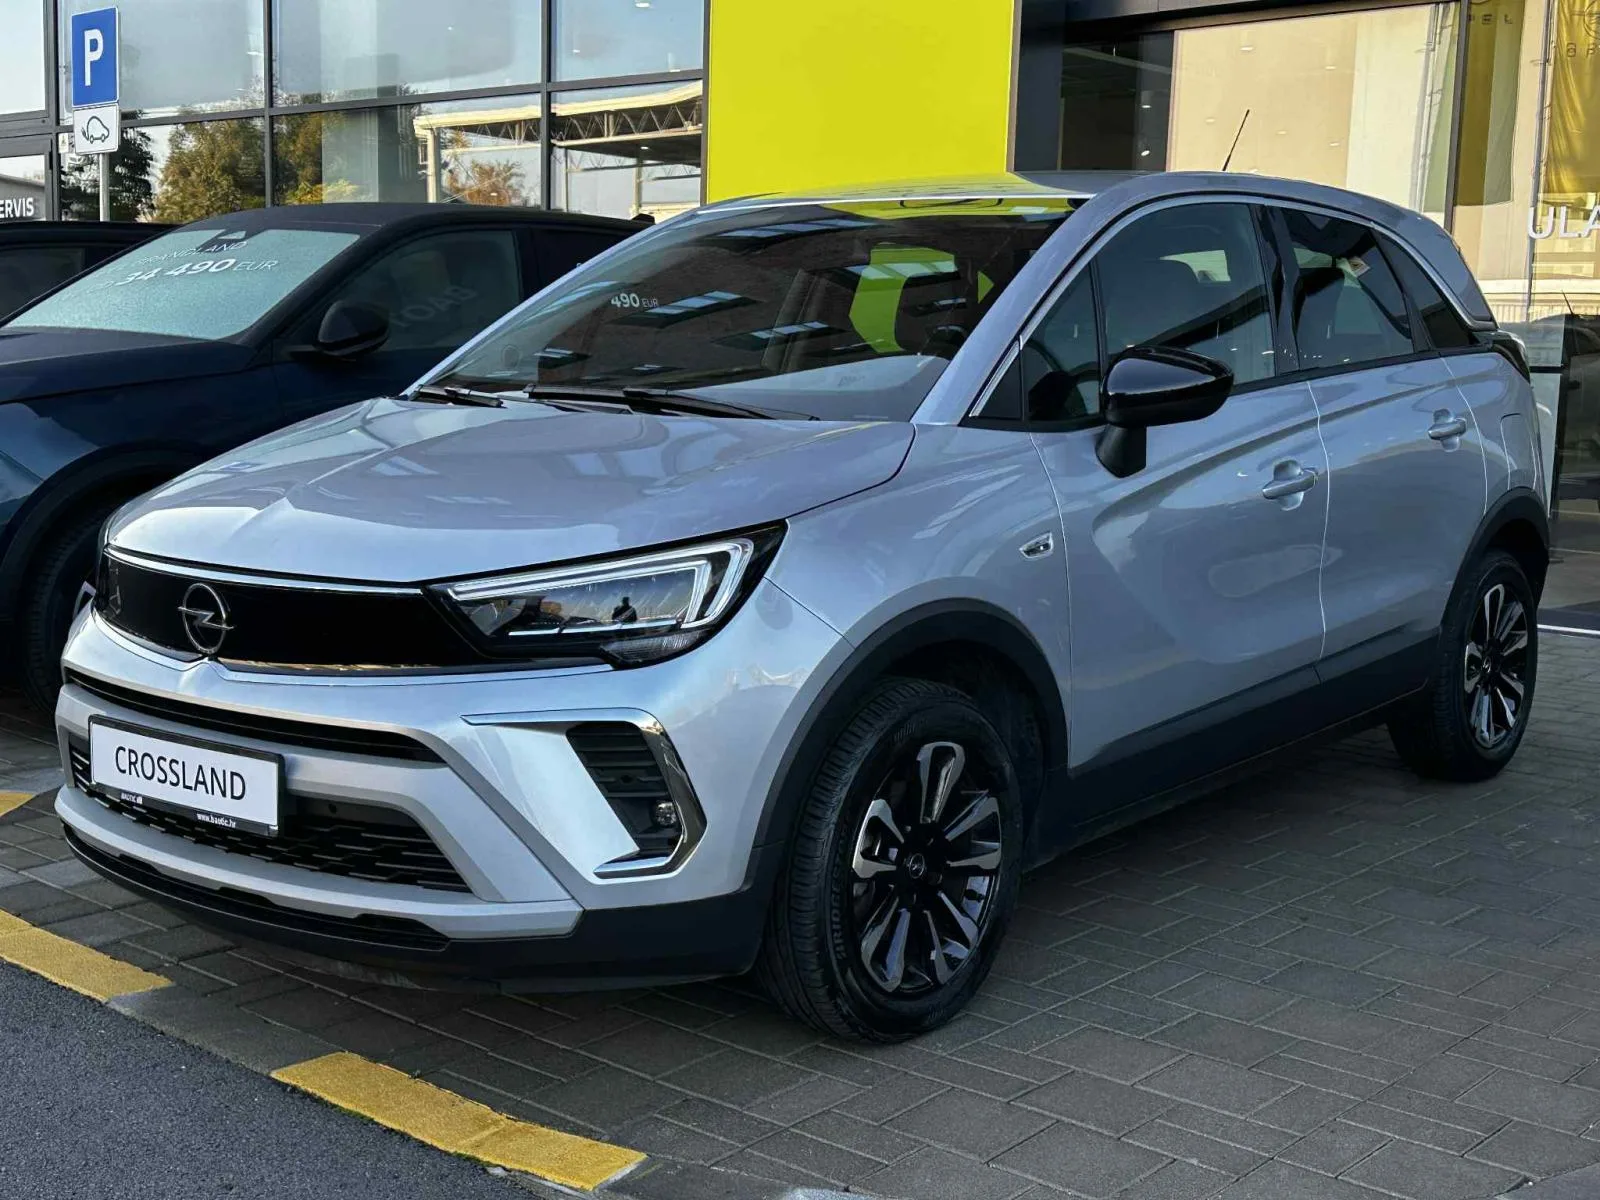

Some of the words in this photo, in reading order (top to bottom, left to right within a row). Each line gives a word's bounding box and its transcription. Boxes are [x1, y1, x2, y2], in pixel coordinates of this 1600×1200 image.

[83, 28, 104, 86] P
[165, 258, 237, 277] 490
[233, 260, 279, 271] EUR
[610, 292, 640, 308] 490
[641, 298, 659, 308] EUR
[115, 746, 246, 800] CROSSLAND
